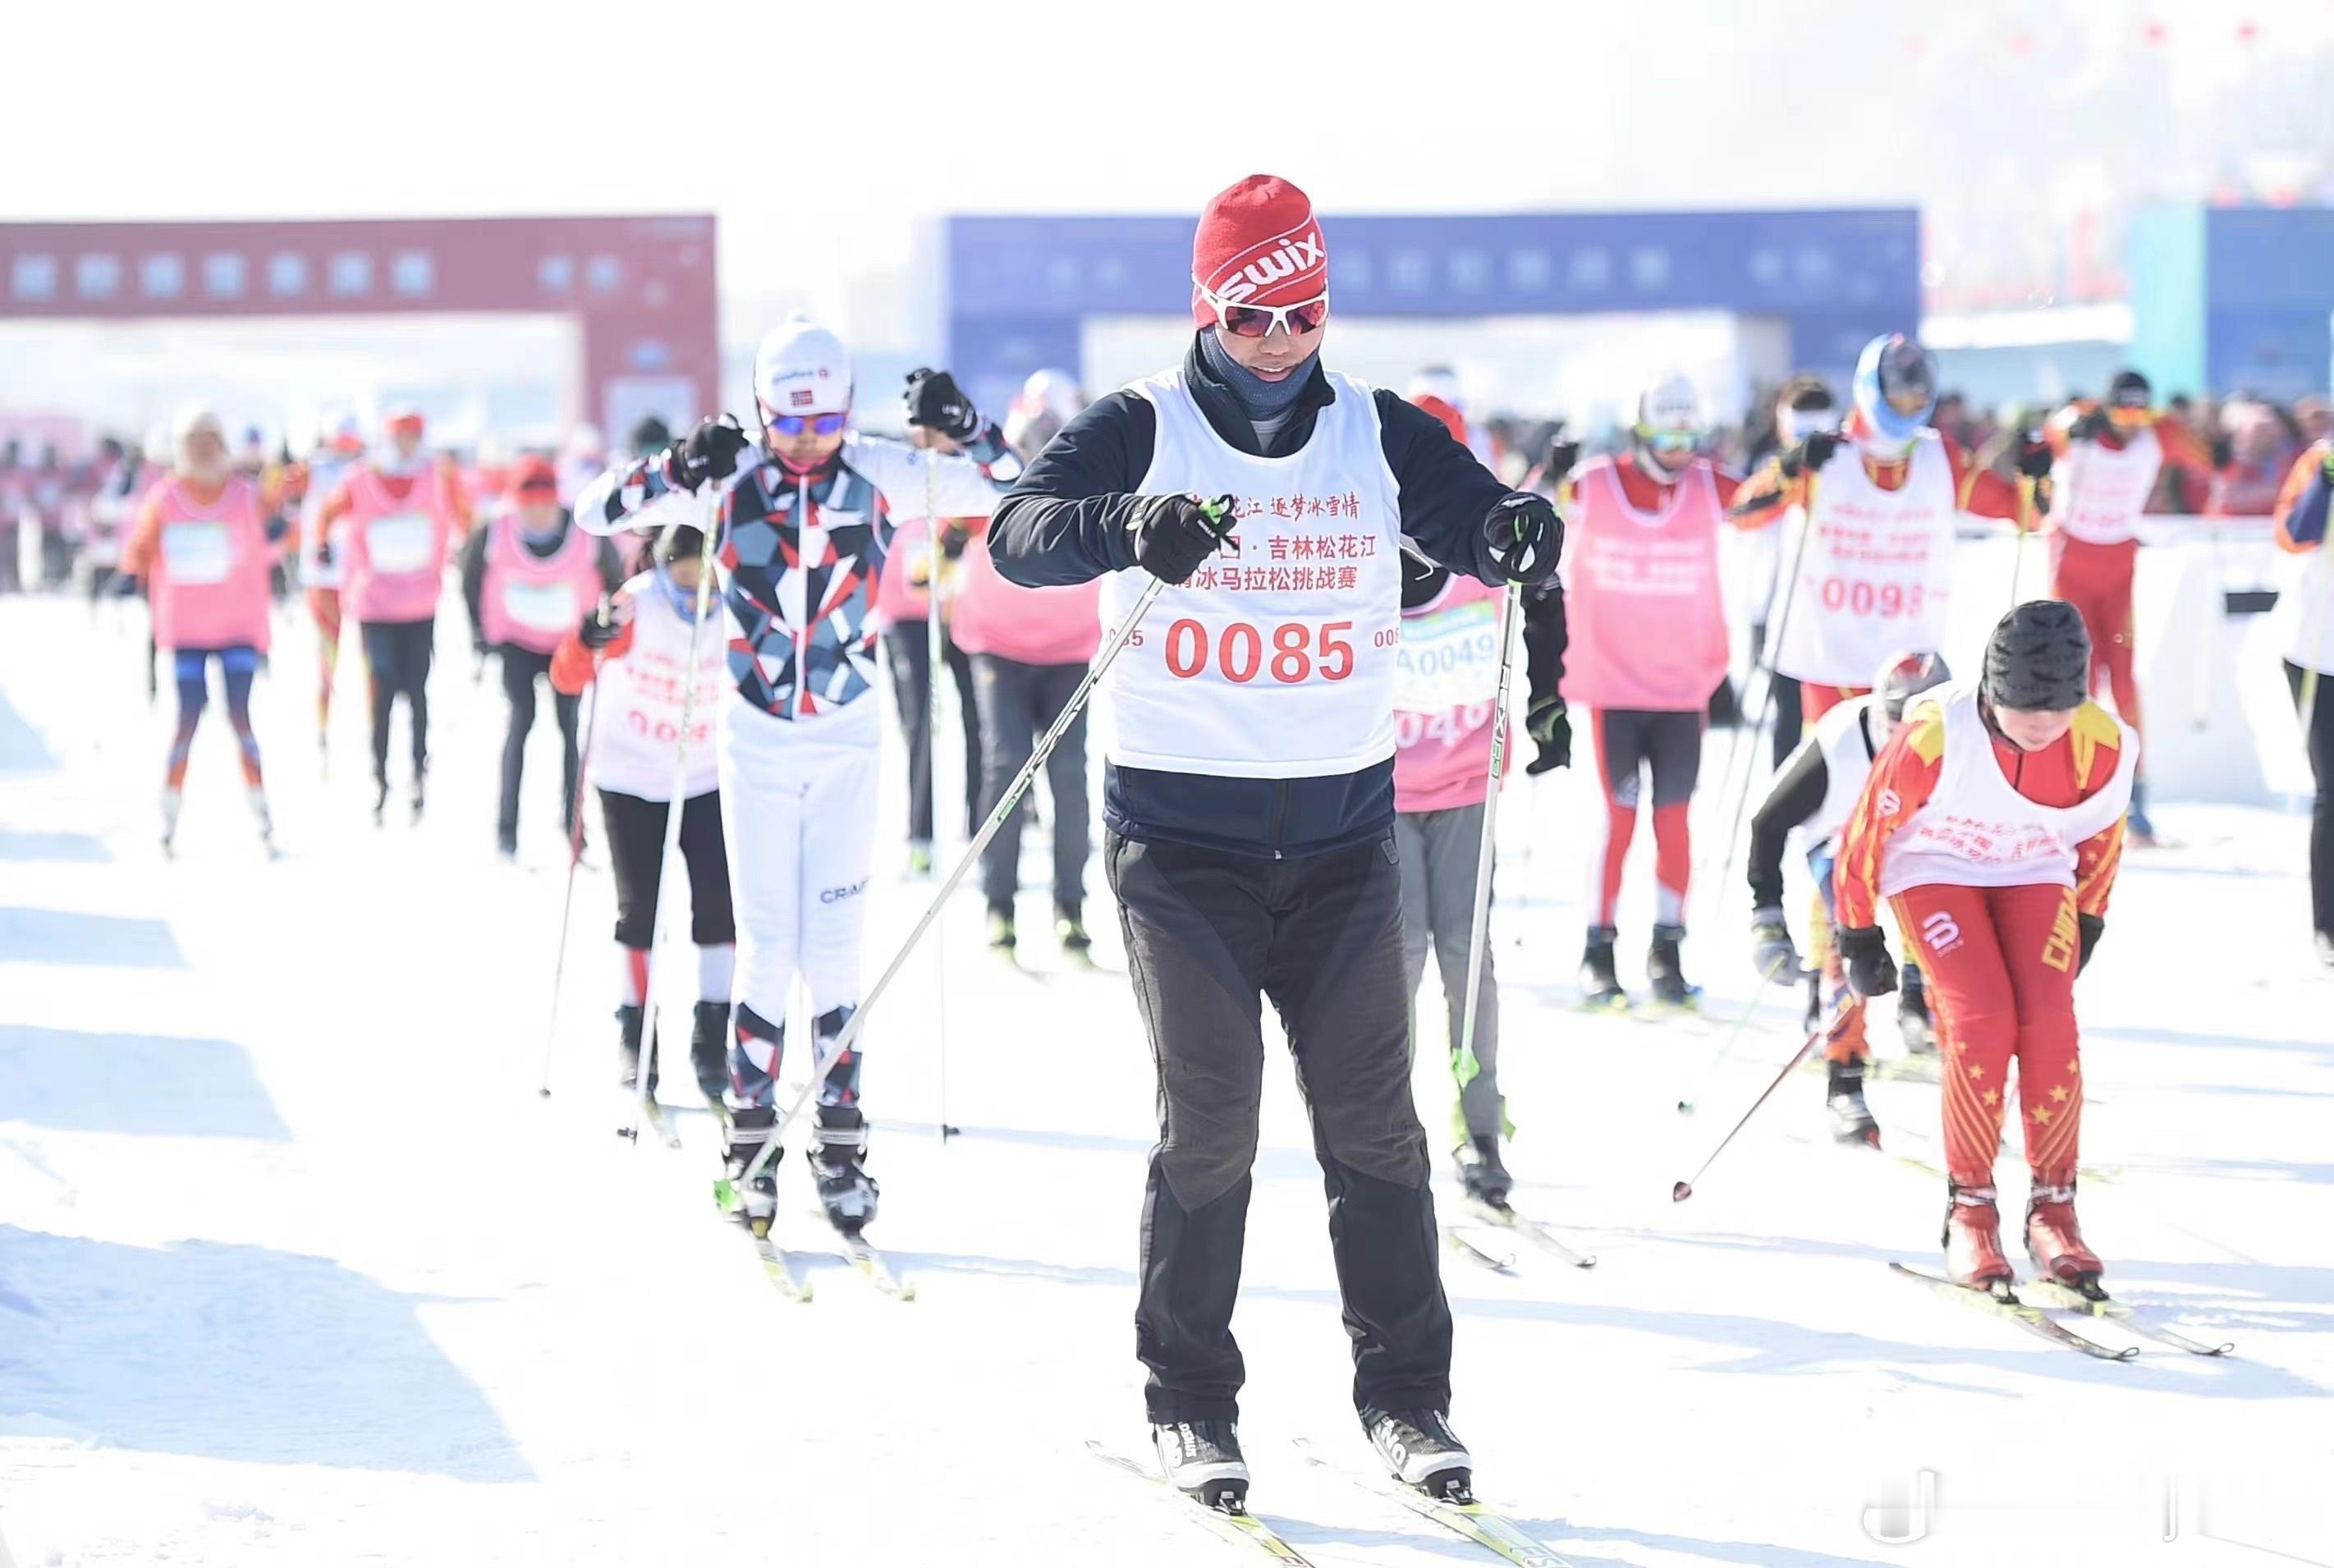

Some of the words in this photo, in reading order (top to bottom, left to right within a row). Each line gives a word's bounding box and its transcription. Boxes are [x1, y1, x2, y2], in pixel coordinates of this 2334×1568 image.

[1270, 491, 1360, 520] 逐梦冰雪情
[1165, 618, 1355, 683] 0085
